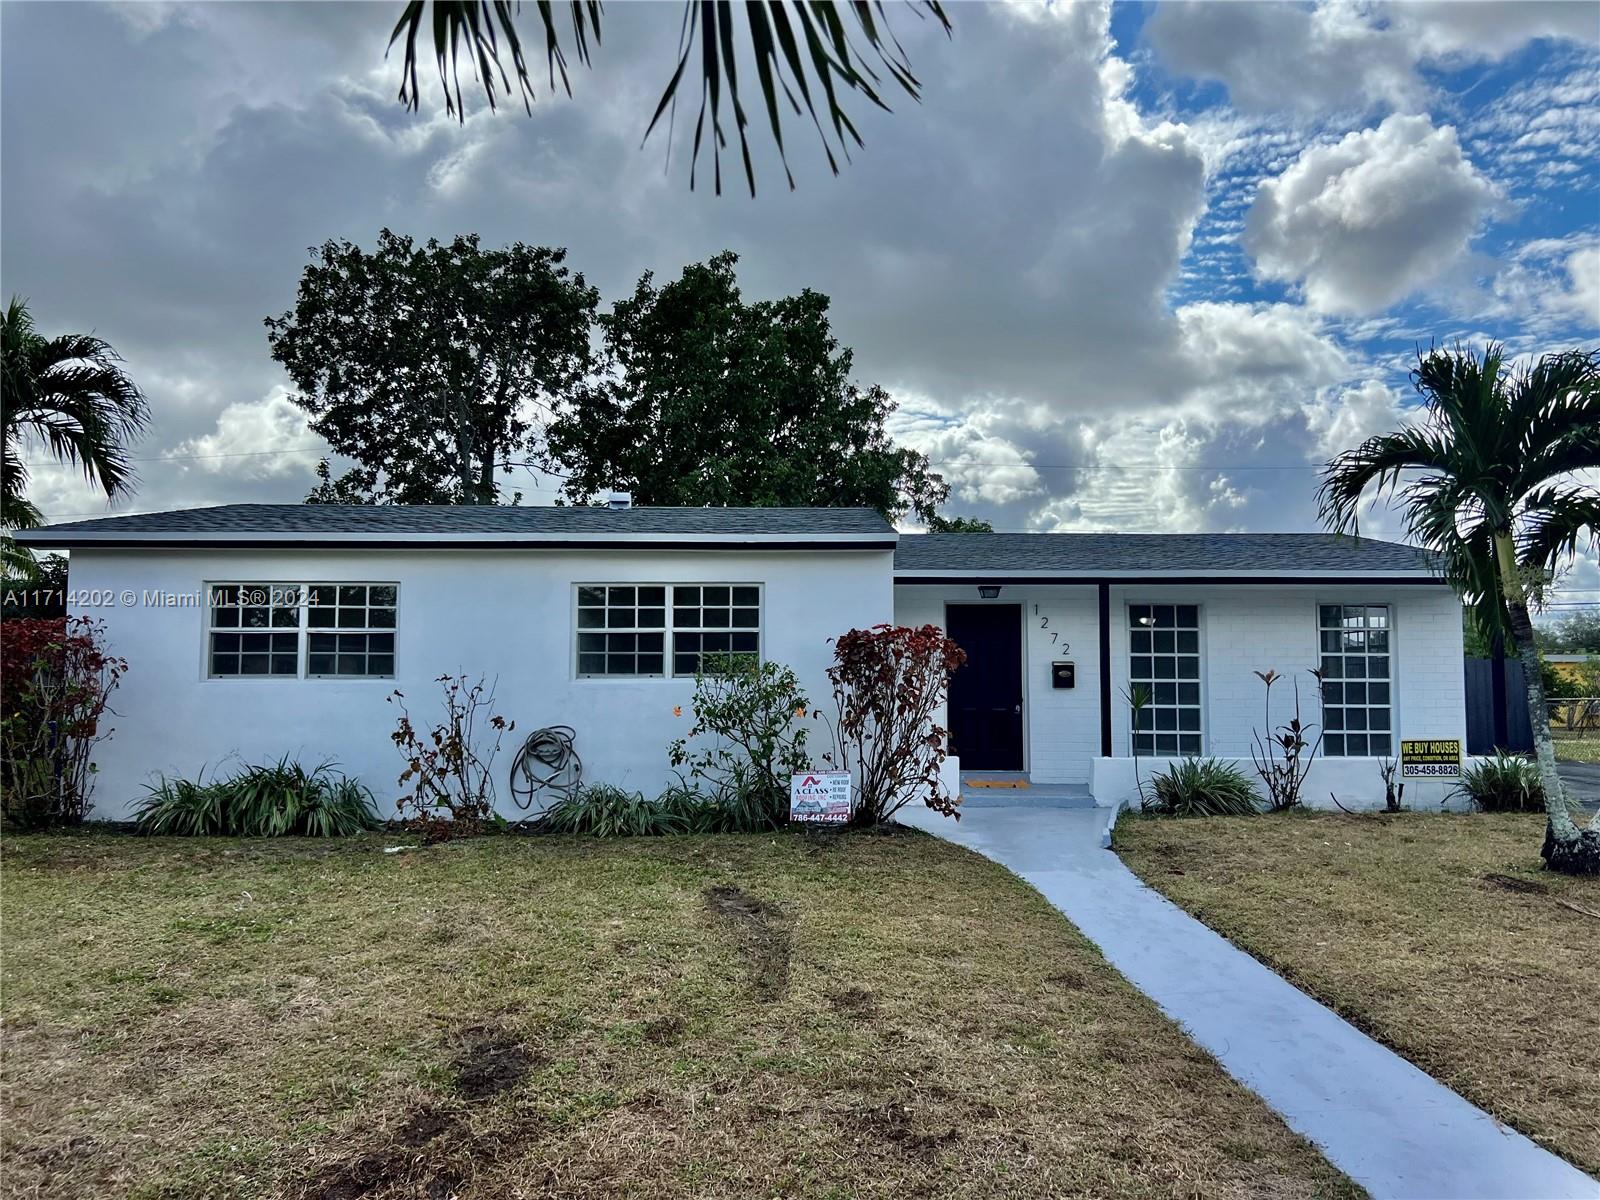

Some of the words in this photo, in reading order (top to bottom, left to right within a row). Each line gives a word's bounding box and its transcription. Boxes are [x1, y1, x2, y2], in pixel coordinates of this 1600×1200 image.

[1402, 743, 1413, 753] WE
[1415, 742, 1428, 753] BUY
[1430, 742, 1458, 753] HOUSES
[1405, 766, 1457, 774] 305-458-8826
